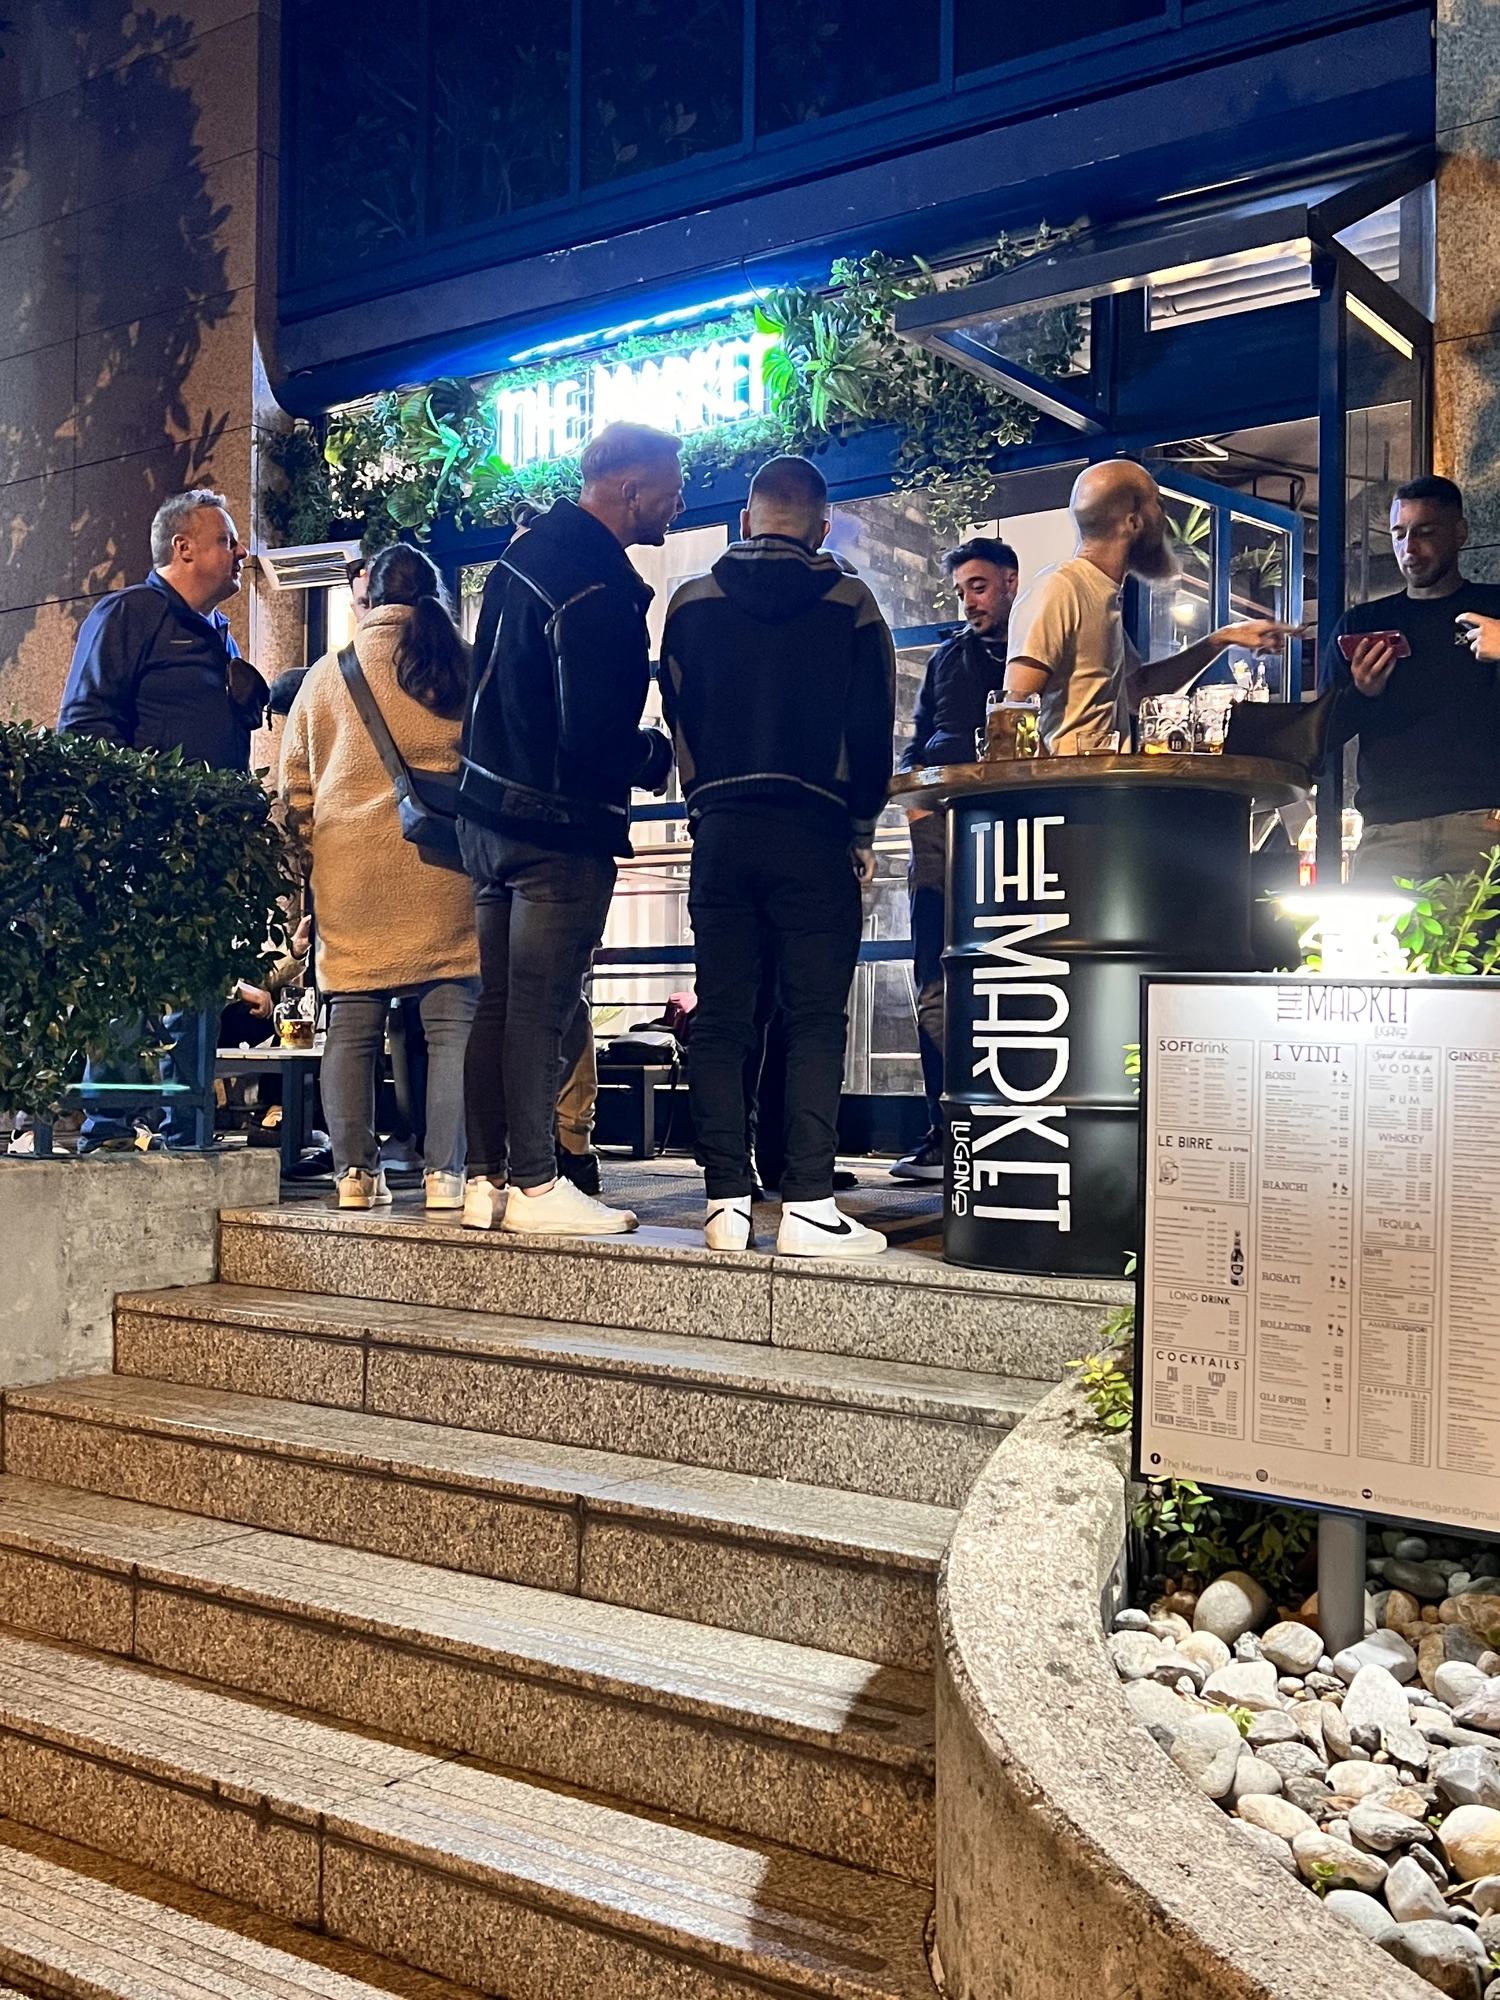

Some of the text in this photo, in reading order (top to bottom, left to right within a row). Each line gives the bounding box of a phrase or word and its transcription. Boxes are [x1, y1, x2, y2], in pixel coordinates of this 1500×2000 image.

[497, 379, 582, 466] THE
[971, 816, 1066, 904] THE
[1306, 985, 1407, 1024] MARKET
[1159, 1040, 1229, 1054] SOFTdrink
[1273, 1044, 1341, 1063] I VINI
[972, 912, 1070, 1232] MARKET
[1265, 1070, 1297, 1081] ROSSI
[1378, 1063, 1432, 1075] VODKA
[1389, 1094, 1420, 1105] RUM
[1158, 1135, 1173, 1147] LE
[1178, 1136, 1213, 1150] BIRRE
[1378, 1132, 1424, 1144] WHISKEY
[950, 1120, 972, 1217] LUGANO
[1262, 1180, 1308, 1192] BIANCHI
[1378, 1218, 1422, 1231] TEQUILA
[1262, 1272, 1301, 1284] ROSATI
[1169, 1291, 1231, 1305] LONG DRINK
[1260, 1320, 1311, 1334] BOLLICINE
[1156, 1350, 1240, 1370] COCKTAILS
[1164, 1458, 1252, 1481] The Market Lugano
